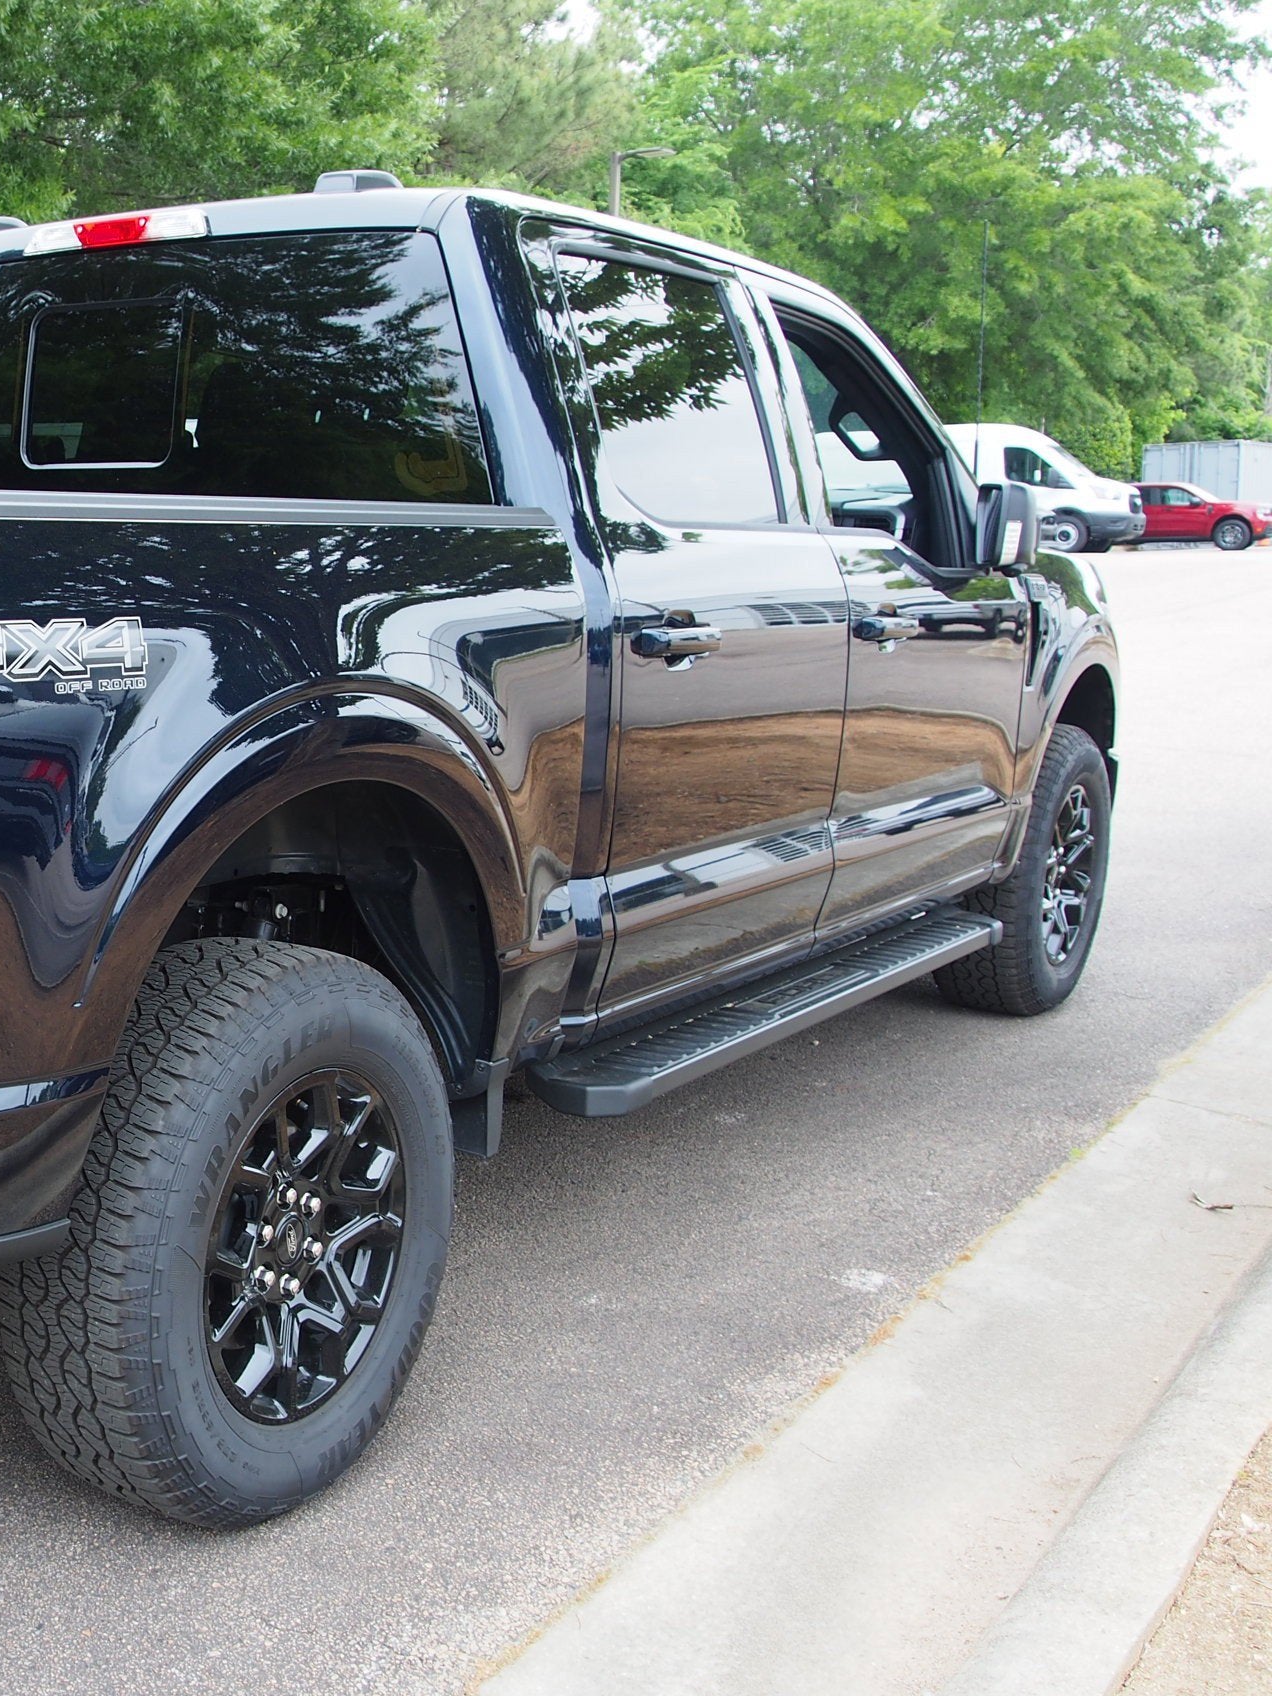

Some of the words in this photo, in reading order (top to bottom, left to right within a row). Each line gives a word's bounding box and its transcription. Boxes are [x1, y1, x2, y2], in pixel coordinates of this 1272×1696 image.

[54, 680, 93, 694] OFF
[99, 677, 147, 692] ROAD
[188, 1014, 336, 1227] WRANGLER
